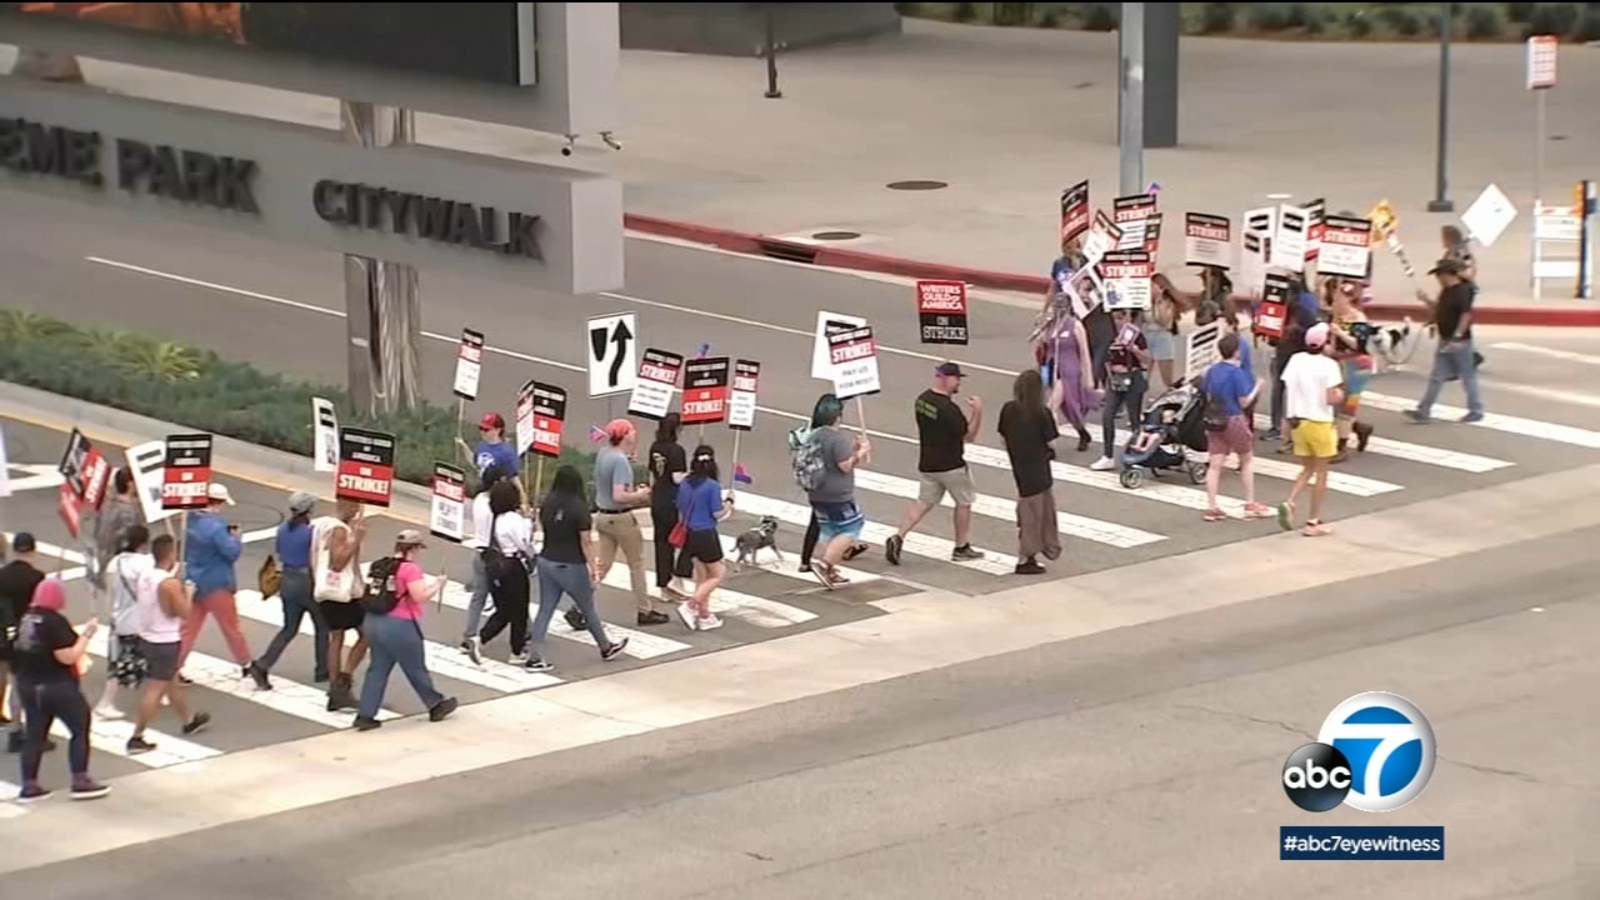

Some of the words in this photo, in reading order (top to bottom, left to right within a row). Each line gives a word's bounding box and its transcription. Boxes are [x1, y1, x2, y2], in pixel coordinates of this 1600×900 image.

[115, 138, 261, 214] PARK
[313, 179, 545, 262] CITYWALK
[1106, 264, 1148, 277] STRIKE!
[920, 284, 961, 295] WRITERS
[923, 292, 951, 301] GUILD
[921, 300, 965, 311] AMERICA
[923, 326, 966, 341] STRIKE
[832, 341, 873, 363] STRIKE!
[640, 363, 677, 384] STRIKE!
[684, 398, 722, 415] STRIKE!
[164, 481, 208, 498] STRIKE!
[339, 473, 390, 496] STRIKE!
